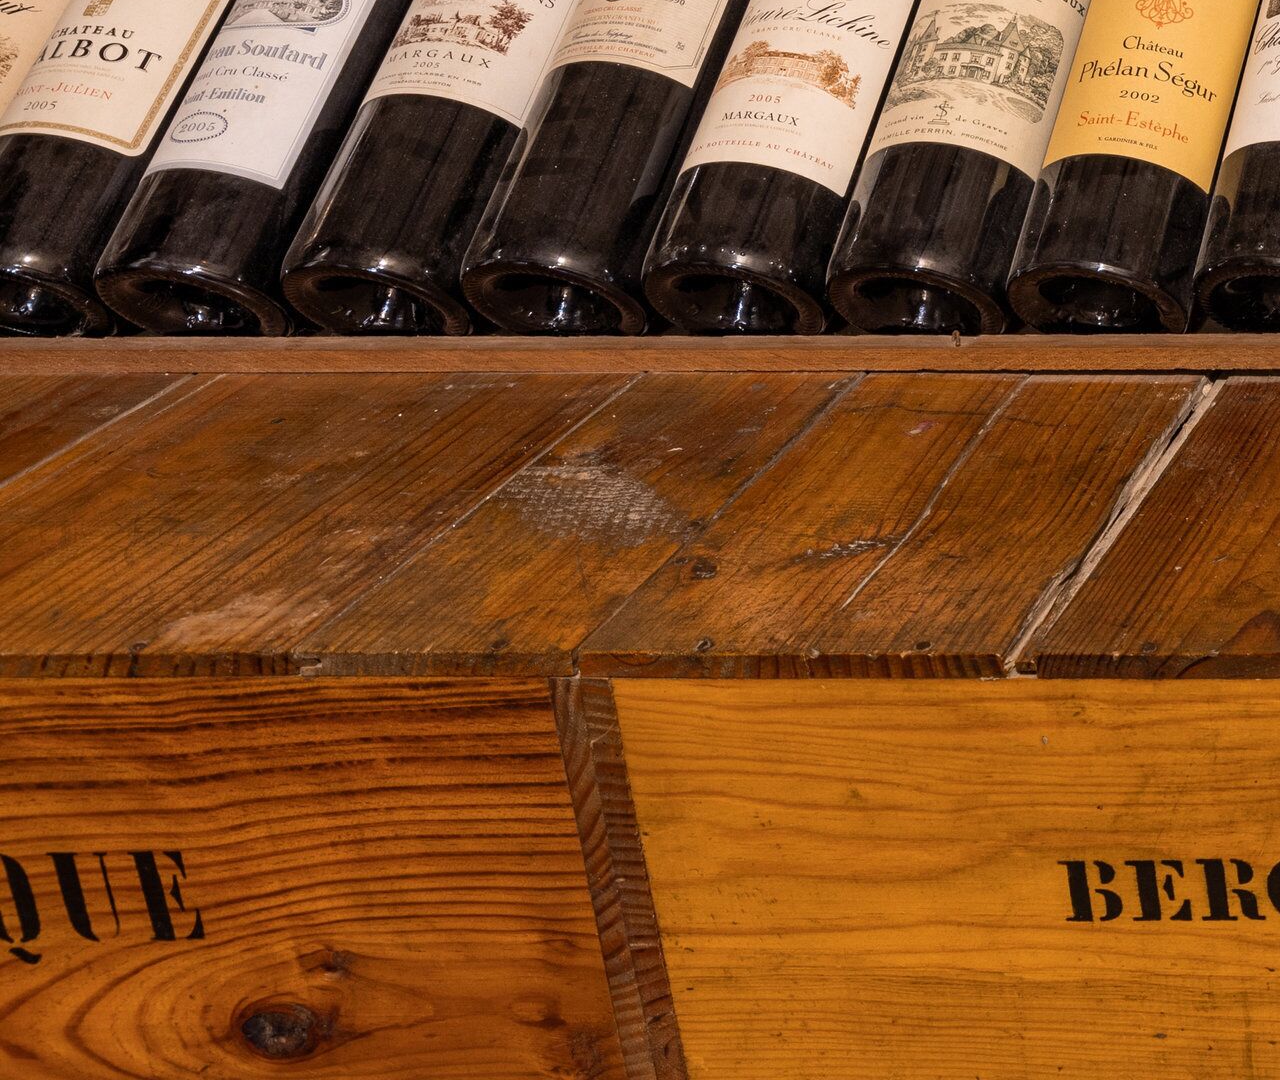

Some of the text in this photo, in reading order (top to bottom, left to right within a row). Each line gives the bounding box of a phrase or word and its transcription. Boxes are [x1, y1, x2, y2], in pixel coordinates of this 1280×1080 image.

[51, 25, 134, 40] CHATEAU
[237, 39, 328, 70] Soutard
[1123, 36, 1184, 59] Château
[387, 50, 491, 68] MARGAUX
[242, 66, 288, 81] Classé
[1079, 59, 1217, 103] Phélan Ségur
[749, 94, 781, 104] 2005
[1119, 90, 1160, 103] 2002
[24, 101, 57, 110] 2005
[722, 110, 800, 127] MARGAUX
[180, 122, 216, 133] 2005
[1078, 110, 1189, 144] Saint-Estèphe
